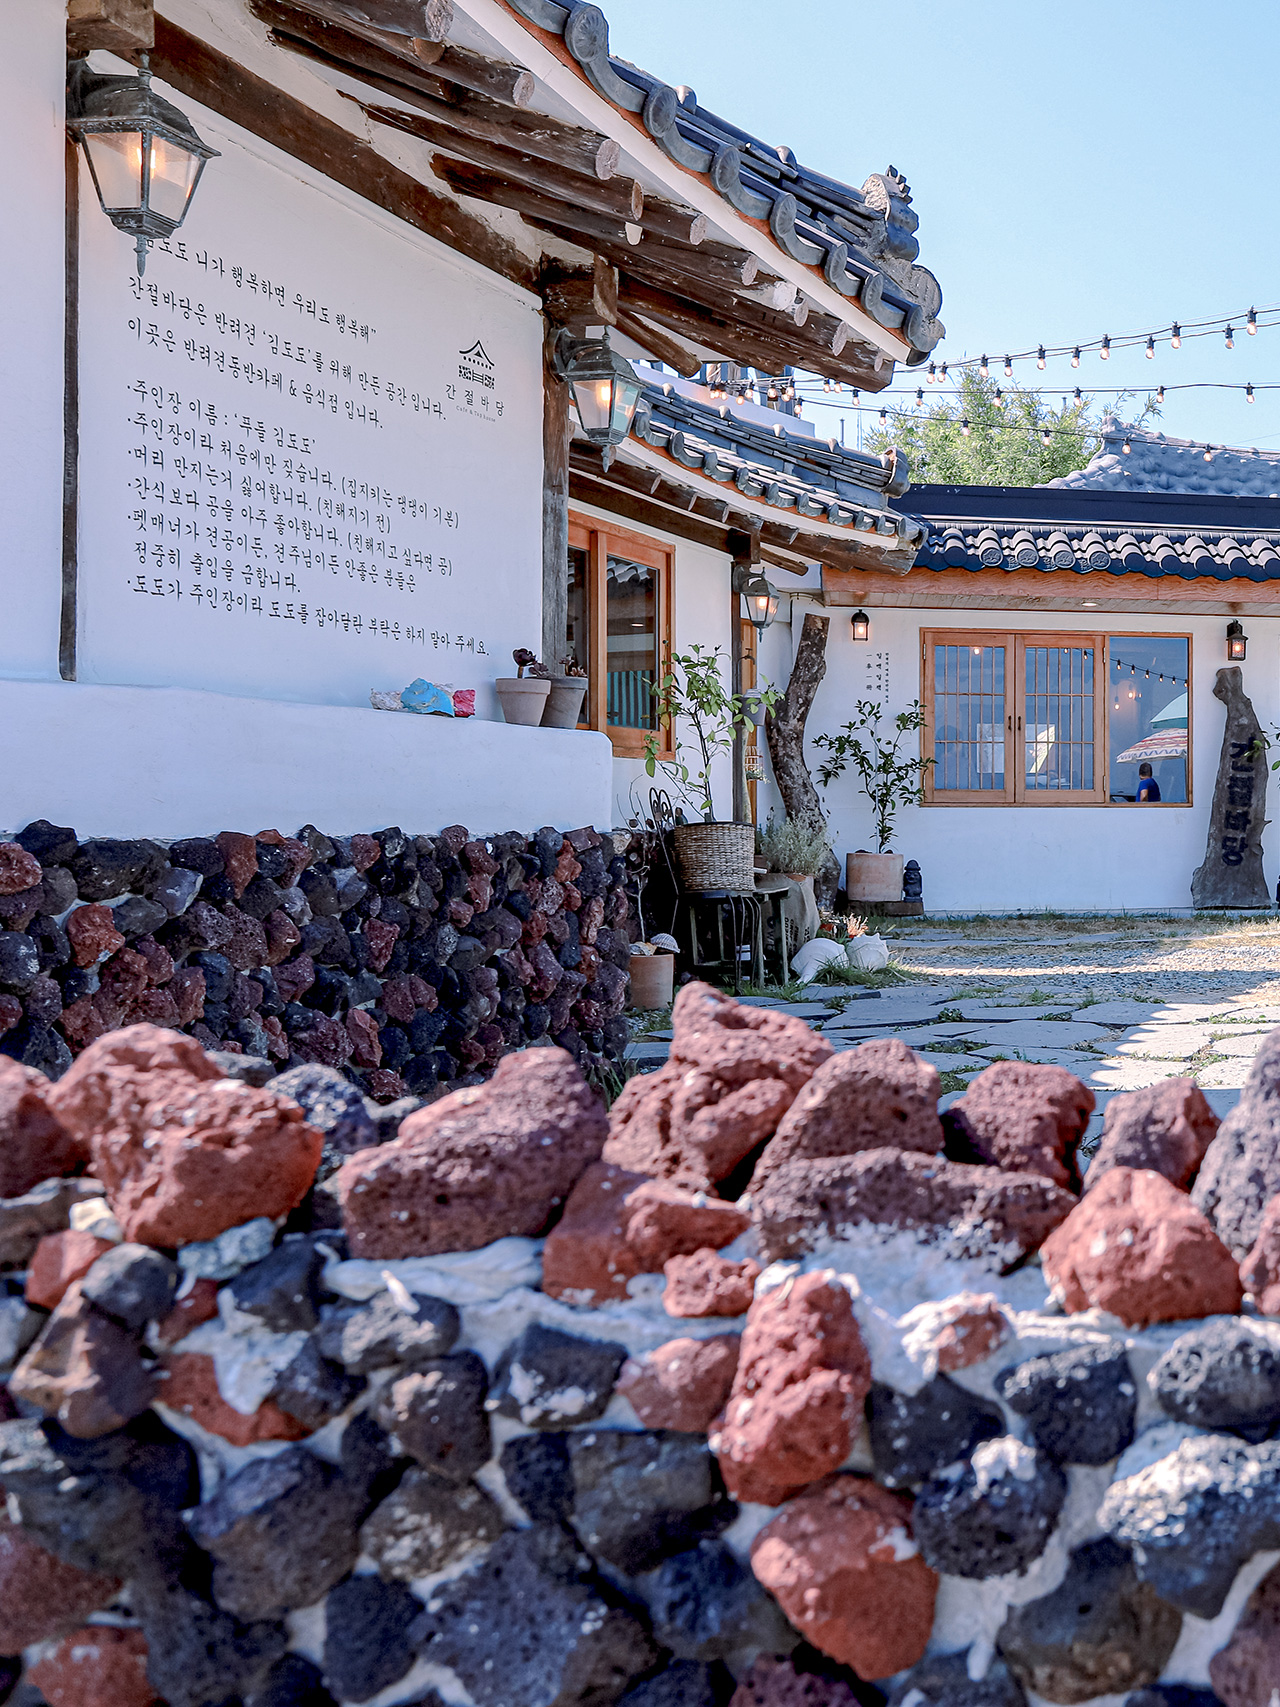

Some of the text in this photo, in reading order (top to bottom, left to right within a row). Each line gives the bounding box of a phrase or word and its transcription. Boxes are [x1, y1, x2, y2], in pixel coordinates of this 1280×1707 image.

[196, 250, 225, 278] 니가
[231, 266, 284, 307] 행복하면
[292, 294, 330, 324] 우리도
[128, 317, 383, 428] 이곳은 반려견동반카페 & 음식점 입니다.
[129, 276, 207, 325] 간절바당은
[215, 312, 255, 346] 반려견
[329, 360, 351, 384] 위해
[358, 372, 380, 395] 만든
[385, 382, 407, 406] 공간
[411, 393, 446, 420] 입니다.
[189, 399, 218, 426] 이름
[174, 456, 232, 491] 만지는거
[240, 475, 311, 511] 싫어합니다.
[318, 497, 369, 528] (친해지기
[376, 514, 390, 534] 전)
[220, 440, 276, 474] 처음에만
[283, 458, 336, 490] 짖습니다.
[398, 495, 427, 519] 댕댕이
[434, 507, 458, 529] 기본)
[134, 541, 300, 593] 정중히 출입을 금합니다.
[206, 495, 234, 521] 공을
[241, 505, 267, 529] 아주
[273, 514, 342, 546] 좋아합니다.
[348, 532, 398, 559] (친해지고
[438, 557, 452, 576] 공)
[206, 526, 267, 559] 견공이든,
[274, 543, 339, 574] 견주님이든
[345, 559, 378, 583] 안좋은
[384, 569, 415, 592] 분들은
[190, 584, 263, 616] 주인장이라
[269, 602, 309, 624] 도도를
[368, 618, 401, 640] 부탁은
[406, 626, 424, 645] 하지
[430, 631, 450, 649] 말아
[455, 636, 489, 655] 주세요.
